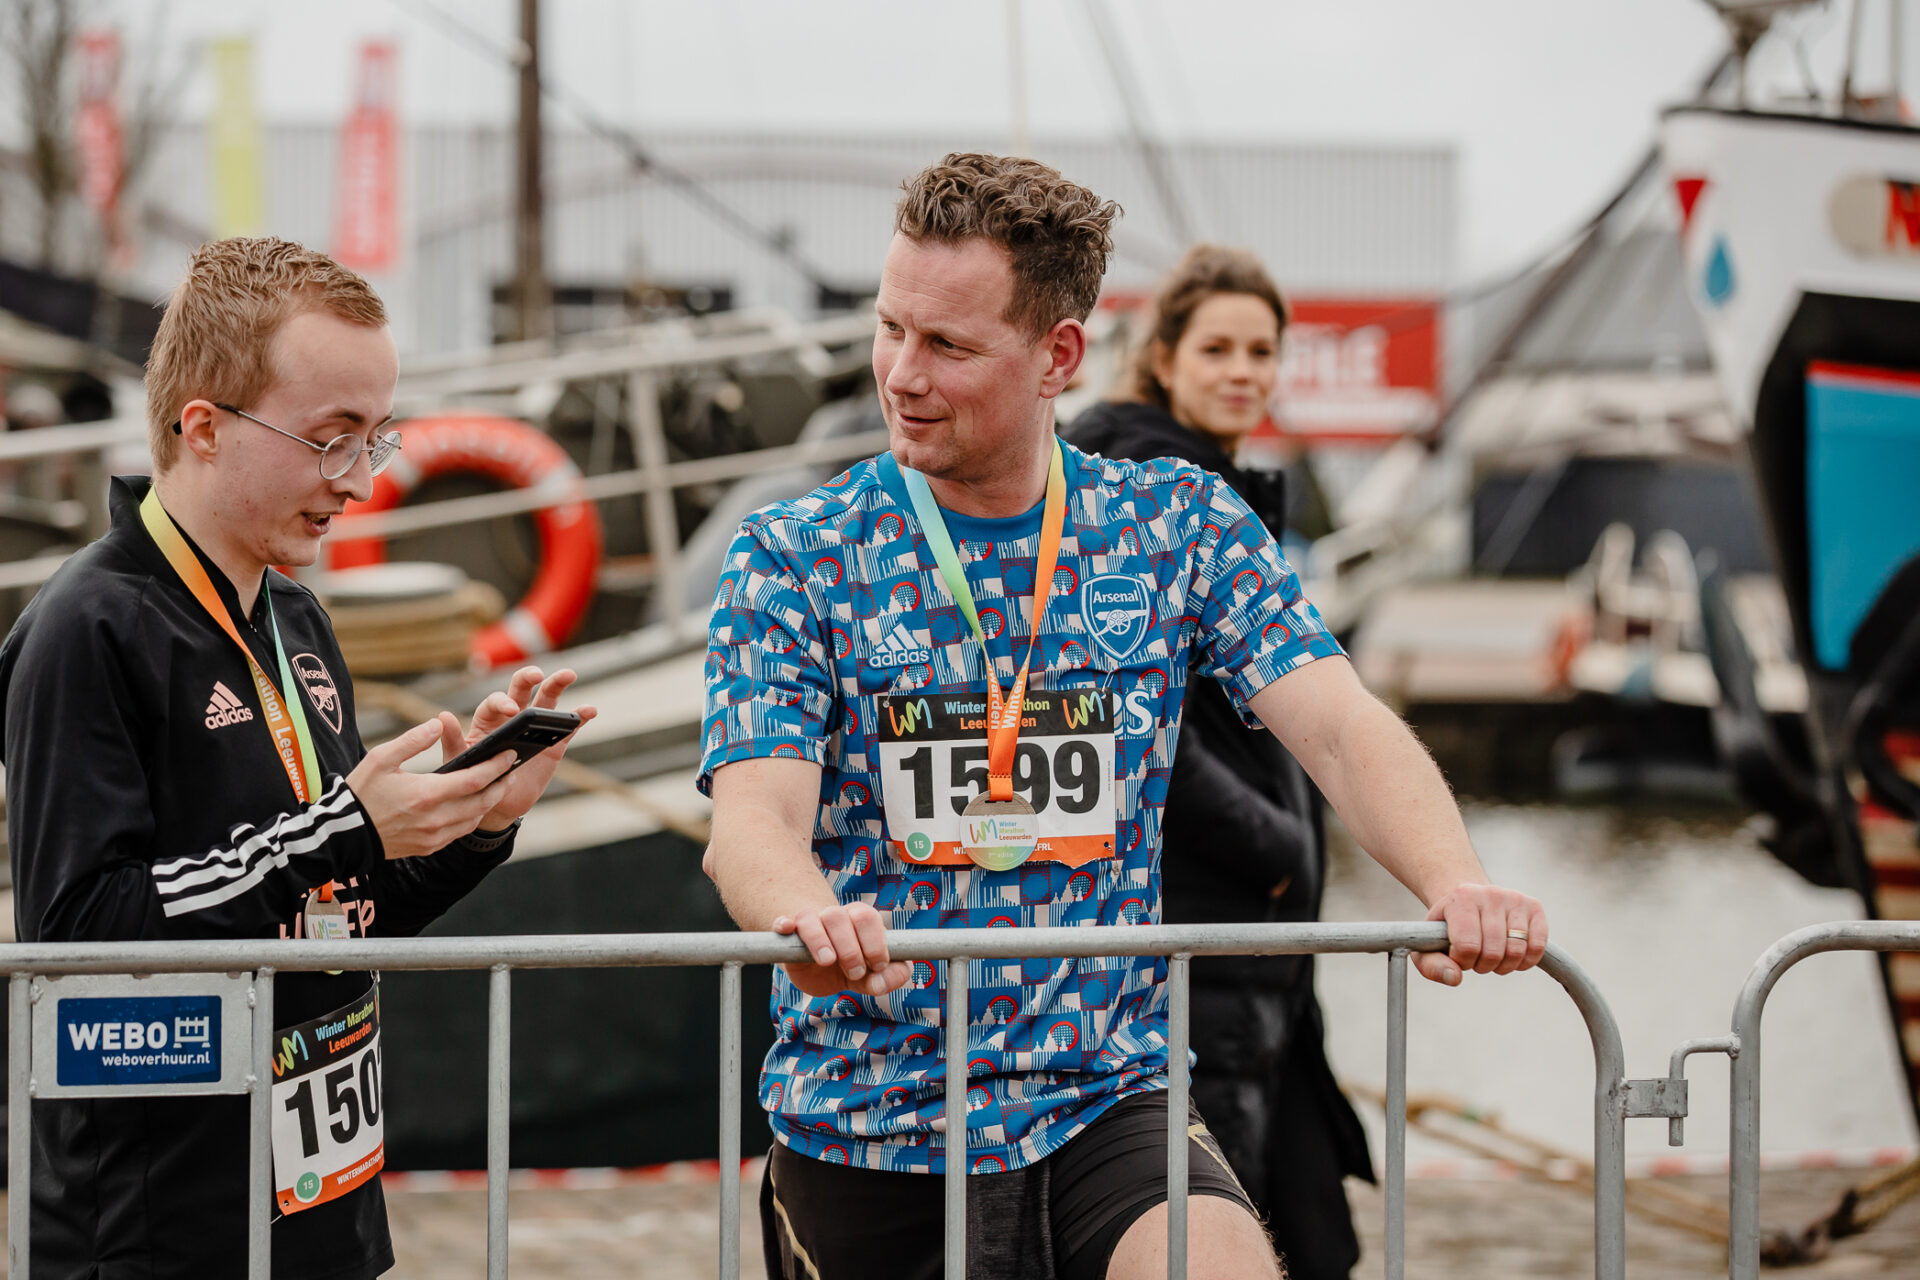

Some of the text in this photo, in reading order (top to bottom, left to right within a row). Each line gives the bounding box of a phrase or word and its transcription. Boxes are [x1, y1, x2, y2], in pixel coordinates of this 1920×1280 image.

[1093, 589, 1139, 604] Arsenal
[869, 649, 930, 668] adidas
[252, 661, 284, 723] rathon
[1001, 678, 1024, 729] Winter
[204, 707, 254, 730] adidas
[944, 700, 986, 715] Winter
[899, 740, 1101, 819] 1599
[913, 840, 924, 850] 15
[315, 1019, 346, 1042] Winter
[346, 1001, 375, 1028] Marathon
[67, 1021, 168, 1051] WEBO
[328, 1021, 372, 1055] Leeuwarden
[102, 1051, 210, 1067] weboverhuur.nl
[284, 1041, 381, 1159] 150
[303, 1179, 314, 1191] 15
